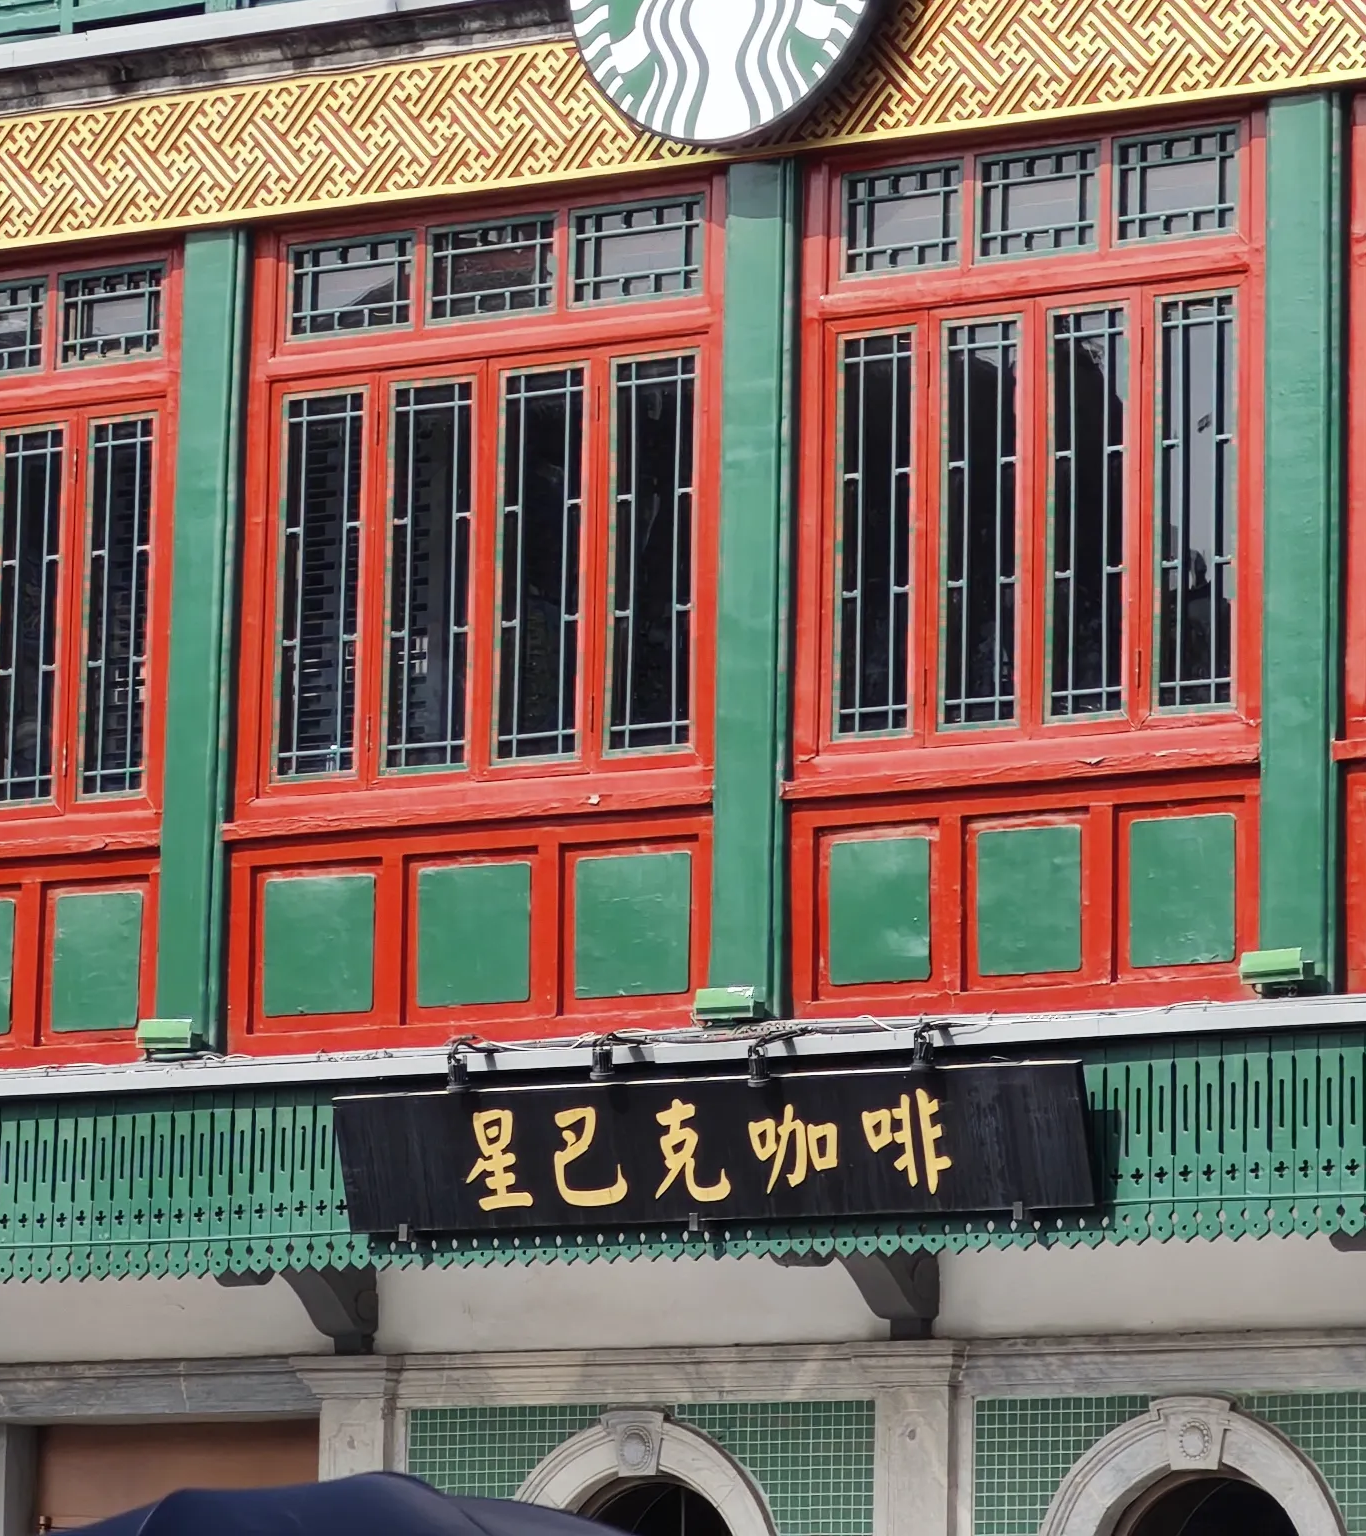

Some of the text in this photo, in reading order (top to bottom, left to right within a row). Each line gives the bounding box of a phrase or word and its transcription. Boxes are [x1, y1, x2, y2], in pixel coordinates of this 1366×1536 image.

[466, 1088, 953, 1211] 星巴克咖啡
